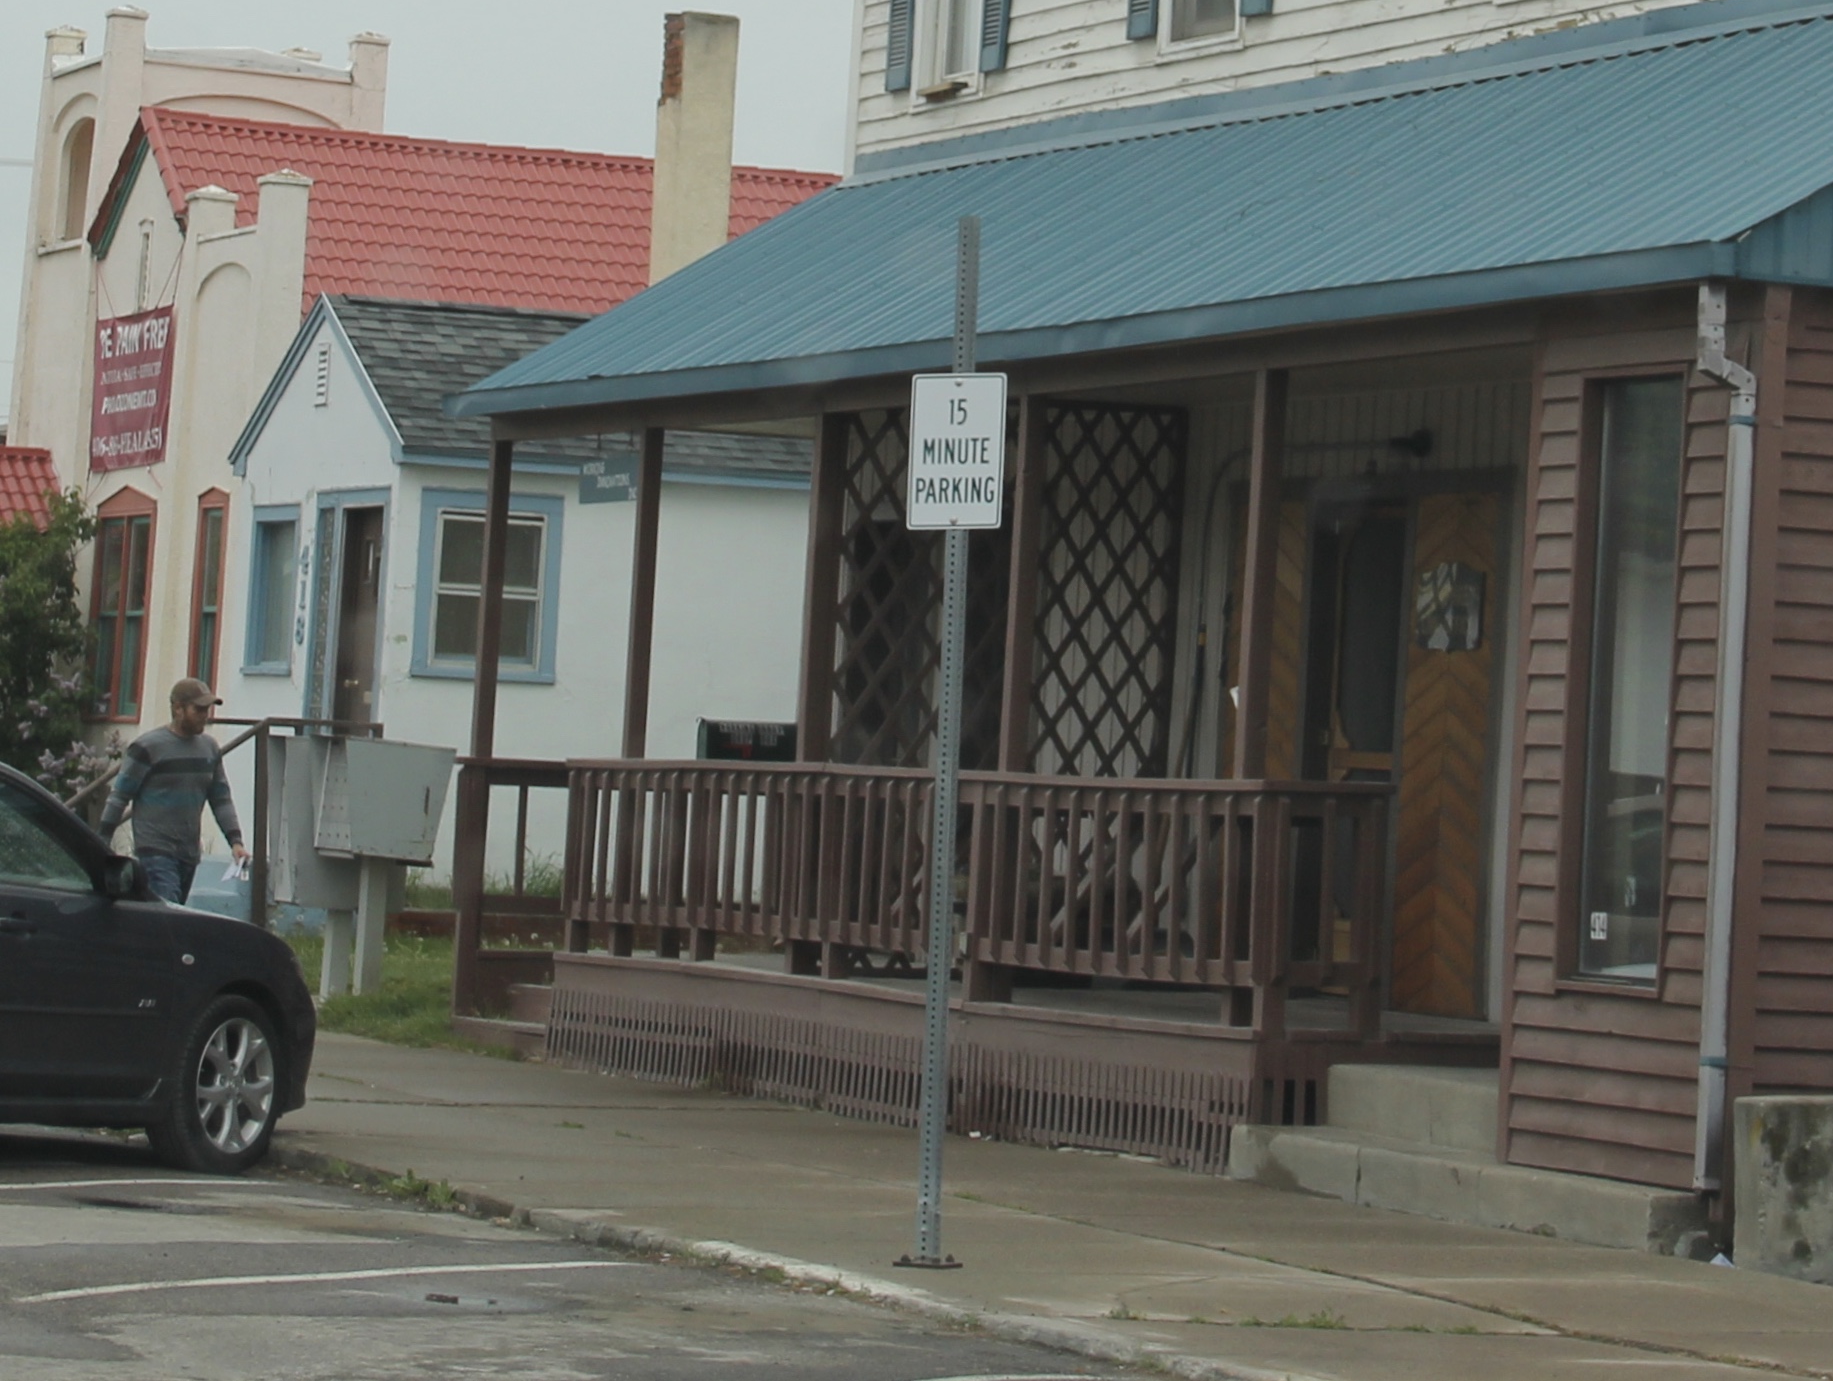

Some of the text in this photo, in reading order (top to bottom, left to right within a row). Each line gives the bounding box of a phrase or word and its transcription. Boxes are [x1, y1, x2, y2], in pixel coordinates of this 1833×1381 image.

[115, 321, 142, 356] PAIN
[949, 398, 967, 425] 15
[922, 438, 990, 465] MINUTE
[915, 477, 995, 504] PARKING
